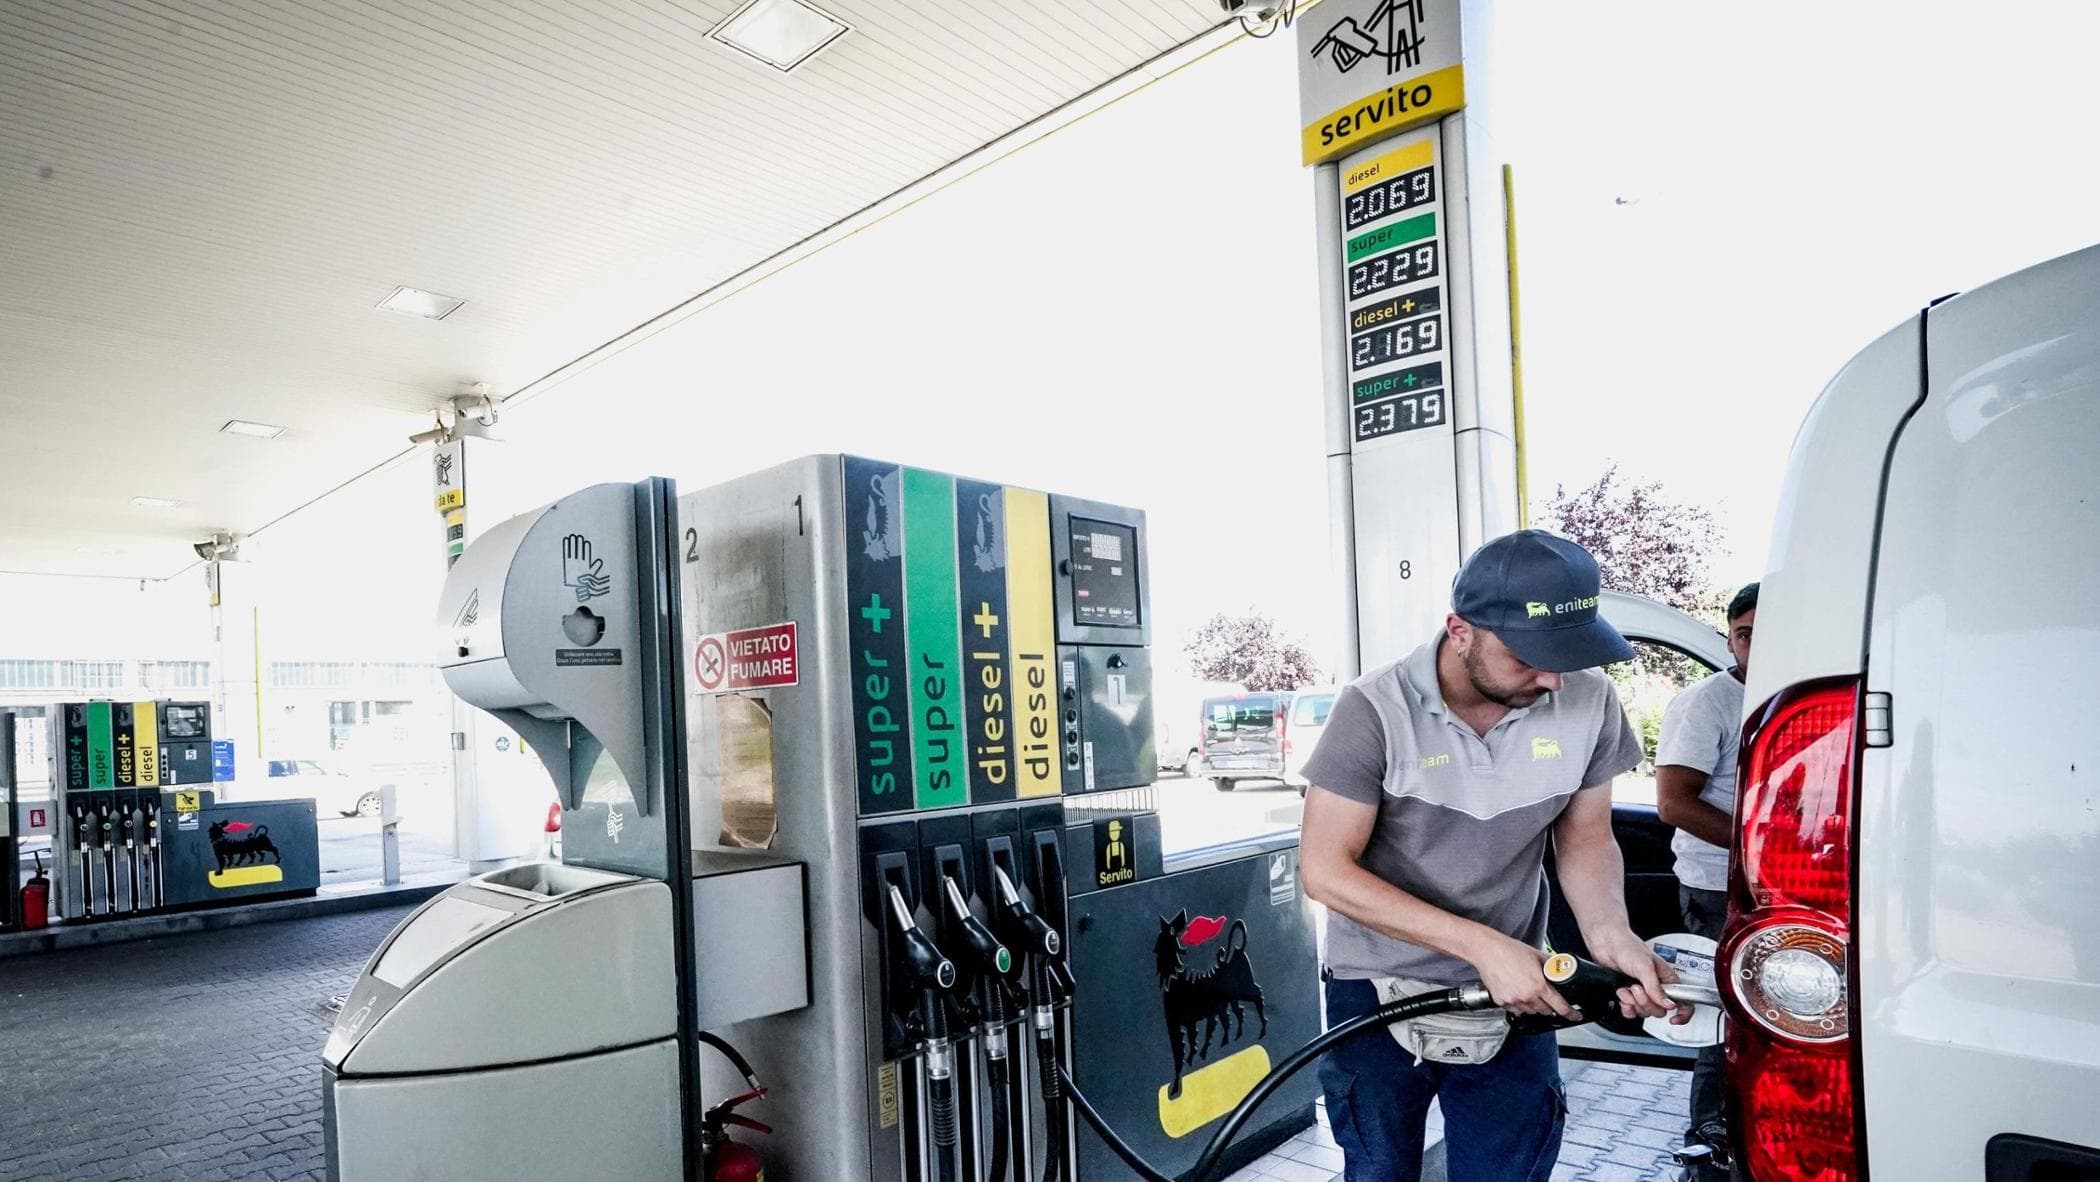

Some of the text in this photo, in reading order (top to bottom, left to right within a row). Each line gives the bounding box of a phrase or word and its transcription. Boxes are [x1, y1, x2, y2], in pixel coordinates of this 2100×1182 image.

[1321, 83, 1432, 146] servito
[1348, 163, 1380, 186] diesel
[1349, 172, 1430, 226] 2.069
[1350, 228, 1394, 253] super
[1352, 245, 1434, 296] 2.229
[1354, 302, 1398, 328] diesel
[1355, 320, 1438, 367] 2.169
[1356, 376, 1399, 398] super
[1359, 394, 1441, 437] 2.379
[794, 494, 804, 536] 1
[685, 527, 699, 563] 2
[1399, 560, 1412, 579] 8
[730, 634, 791, 657] VIETATO
[730, 657, 793, 680] FUMARE
[864, 650, 900, 795] super
[922, 652, 955, 791] super
[973, 652, 1007, 785] diesel
[1019, 654, 1050, 780] diesel
[71, 749, 85, 786] super
[95, 748, 108, 785] super
[117, 746, 132, 783] diesel
[139, 746, 154, 782] diesel
[188, 750, 195, 760] 5
[1099, 867, 1133, 885] Servito
